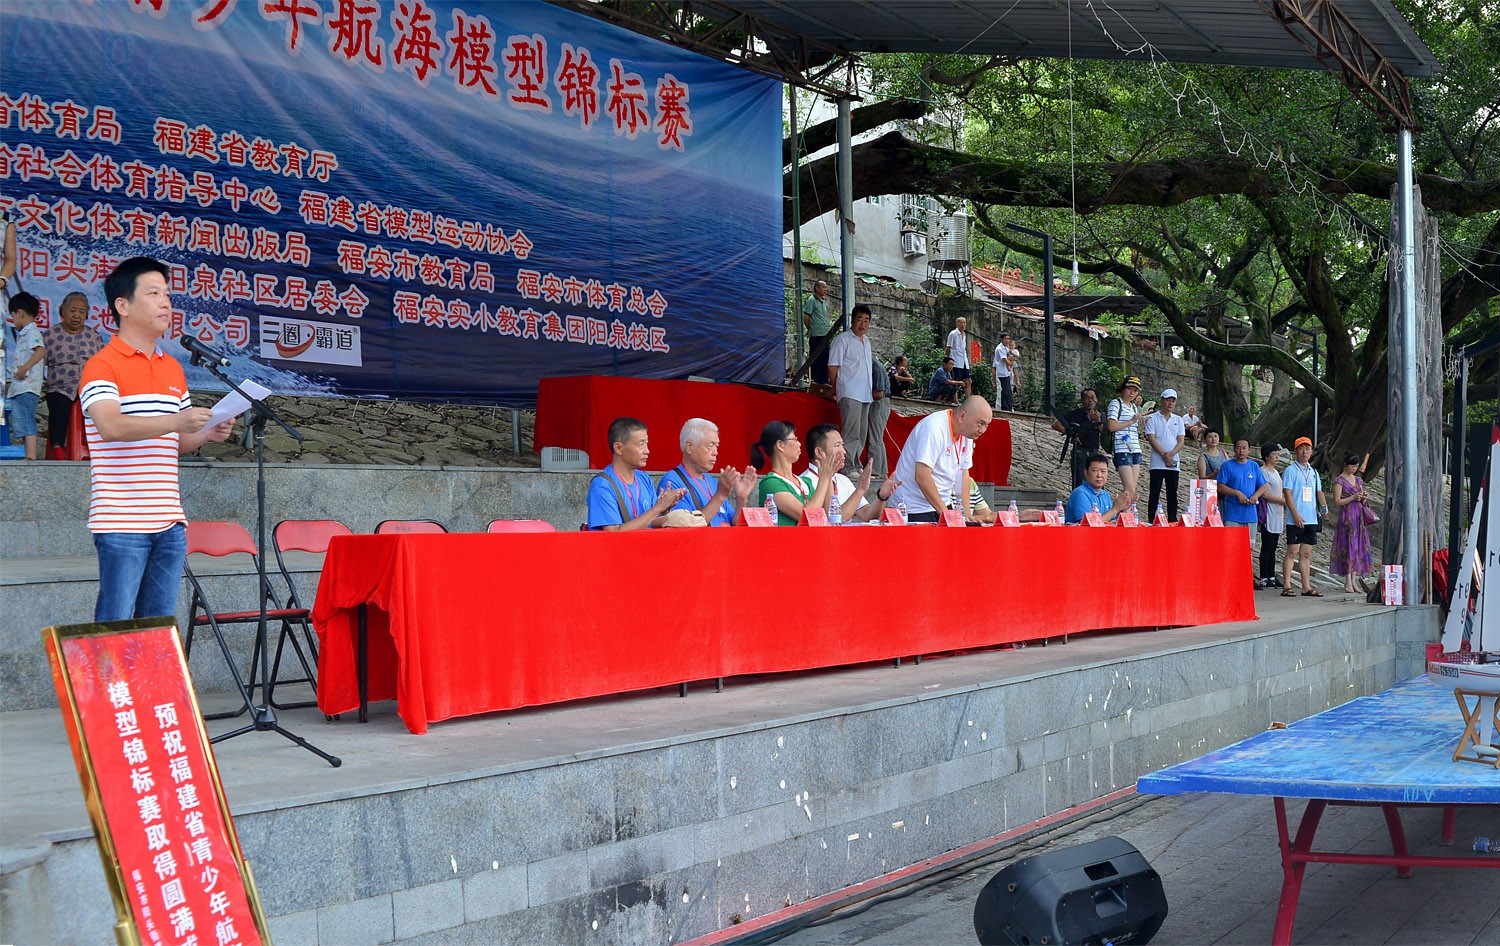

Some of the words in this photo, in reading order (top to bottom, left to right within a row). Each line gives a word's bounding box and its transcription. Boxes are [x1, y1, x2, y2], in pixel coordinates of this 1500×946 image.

[131, 0, 689, 147] 年航海模型锦标赛
[156, 119, 336, 180] 福建省教育厅
[301, 192, 532, 258] 福建省模型运动协会
[20, 248, 368, 317] 阳头街阳泉社区居委会
[394, 291, 669, 352] 福安实小教育集团阳泉校区
[338, 241, 494, 291] 福安市教育局
[517, 270, 667, 316] 福安市体育总会
[154, 702, 242, 946] 预祝福建省青少年航
[131, 869, 162, 946] 福安市阳头街
